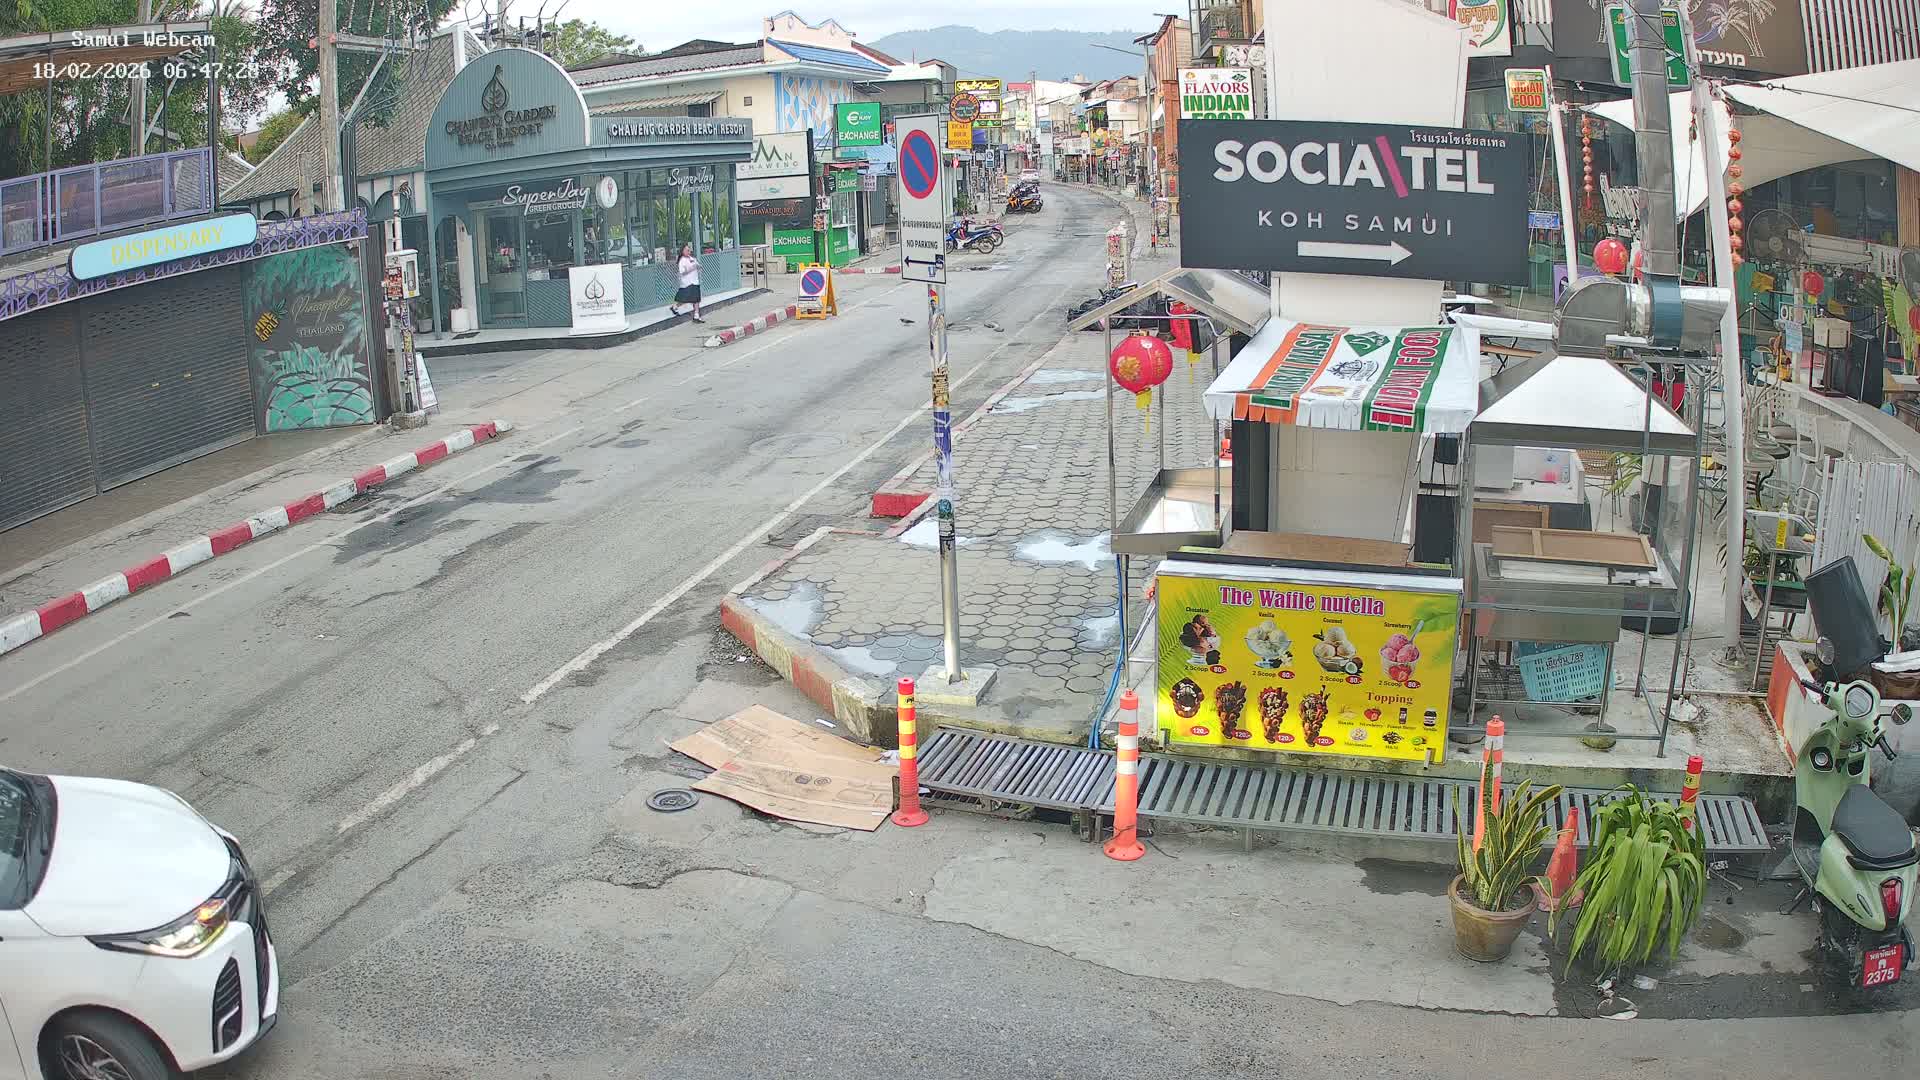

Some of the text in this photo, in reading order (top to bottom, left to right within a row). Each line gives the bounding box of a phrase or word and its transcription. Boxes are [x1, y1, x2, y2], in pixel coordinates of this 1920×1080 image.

[1184, 82, 1249, 94] FLAVORS
[1511, 81, 1544, 93] INDIAN
[1183, 94, 1250, 112] INDIAN
[1513, 94, 1543, 107] FOOD
[503, 104, 557, 124] GARDEN
[610, 123, 746, 137] CHAWENG GARDEN BEACH RESORT
[838, 130, 879, 140] EXCHANGE
[1257, 210, 1452, 236] KOH SAMUI
[111, 223, 224, 266] DISPENSARY
[773, 236, 812, 246] EXCHANGE
[906, 240, 938, 250] NO PARKING
[299, 323, 345, 337] THAILAND
[1219, 585, 1386, 617] The Waffle nutella
[1185, 606, 1209, 614] Chocolate
[1384, 621, 1412, 630] Strawberry
[1569, 651, 1584, 661] 789
[1325, 675, 1344, 683] Scoop
[1383, 680, 1403, 688] Scoop
[1366, 691, 1413, 705] Topping
[1866, 967, 1895, 985] 2375
